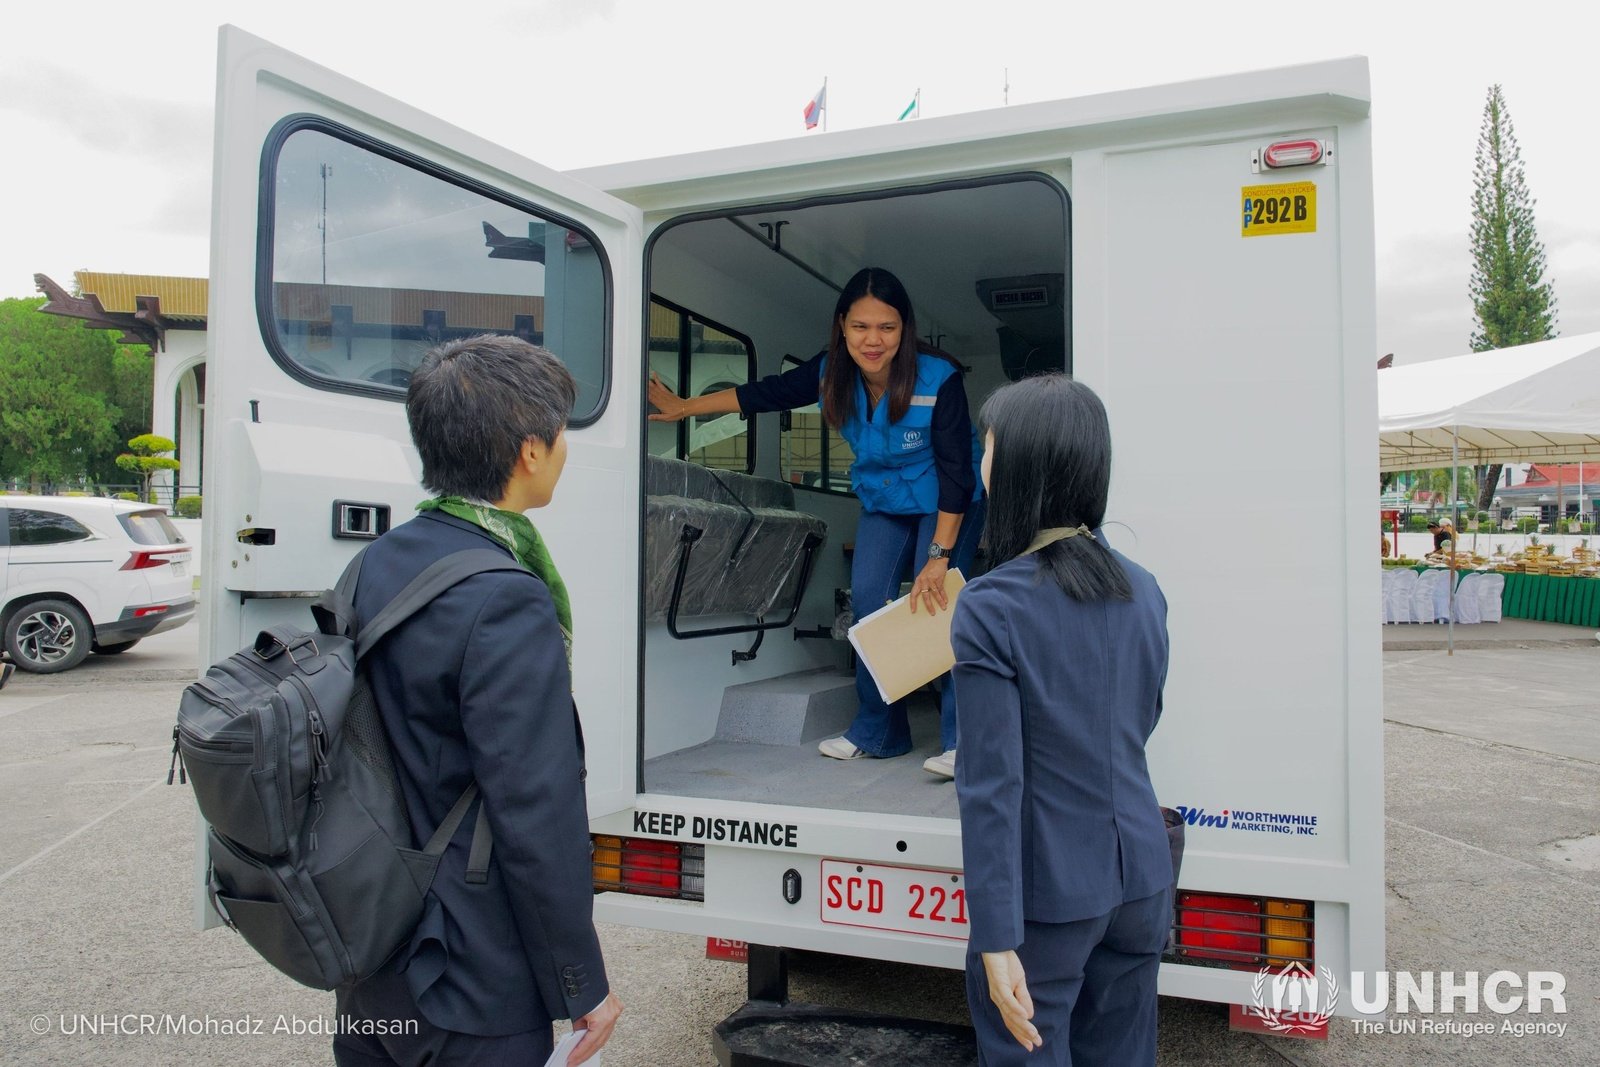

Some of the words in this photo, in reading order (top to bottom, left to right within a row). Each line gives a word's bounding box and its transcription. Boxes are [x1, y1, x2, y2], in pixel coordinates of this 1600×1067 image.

[1243, 188, 1286, 197] CONDUCTION
[1287, 184, 1316, 195] STICKER
[1231, 810, 1317, 826] WORTHWHILE
[633, 811, 686, 836] KEEP
[692, 816, 798, 847] DISTANCE
[1231, 821, 1294, 835] MARKETING,
[1296, 826, 1318, 836] INC.
[827, 875, 884, 913] SCD
